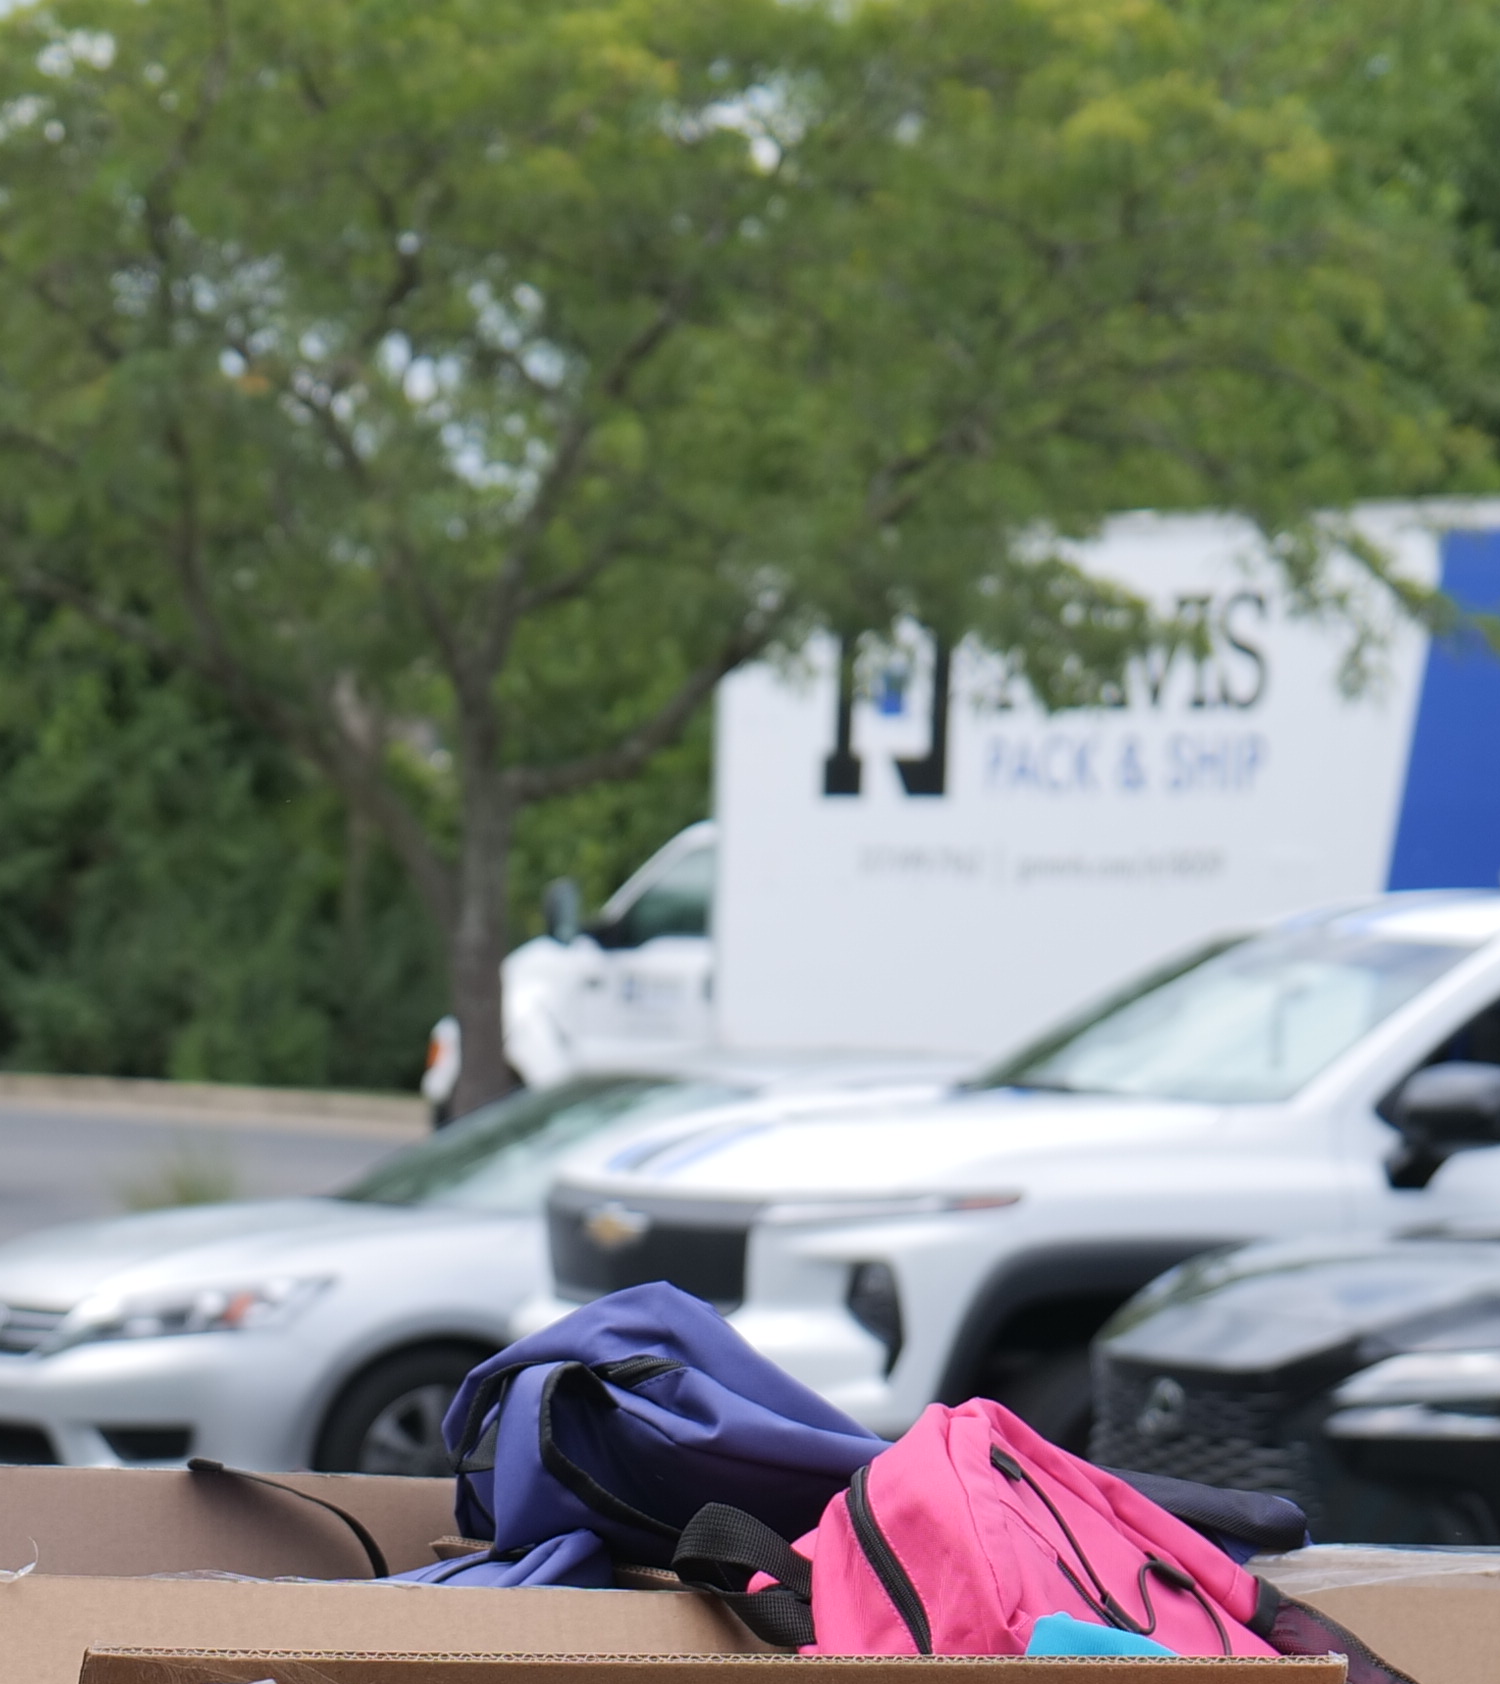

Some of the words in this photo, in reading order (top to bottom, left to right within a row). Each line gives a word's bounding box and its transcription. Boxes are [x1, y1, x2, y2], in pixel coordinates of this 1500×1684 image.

[986, 731, 1101, 791] PACK
[1116, 732, 1147, 791] &
[1166, 731, 1270, 792] SHIP
